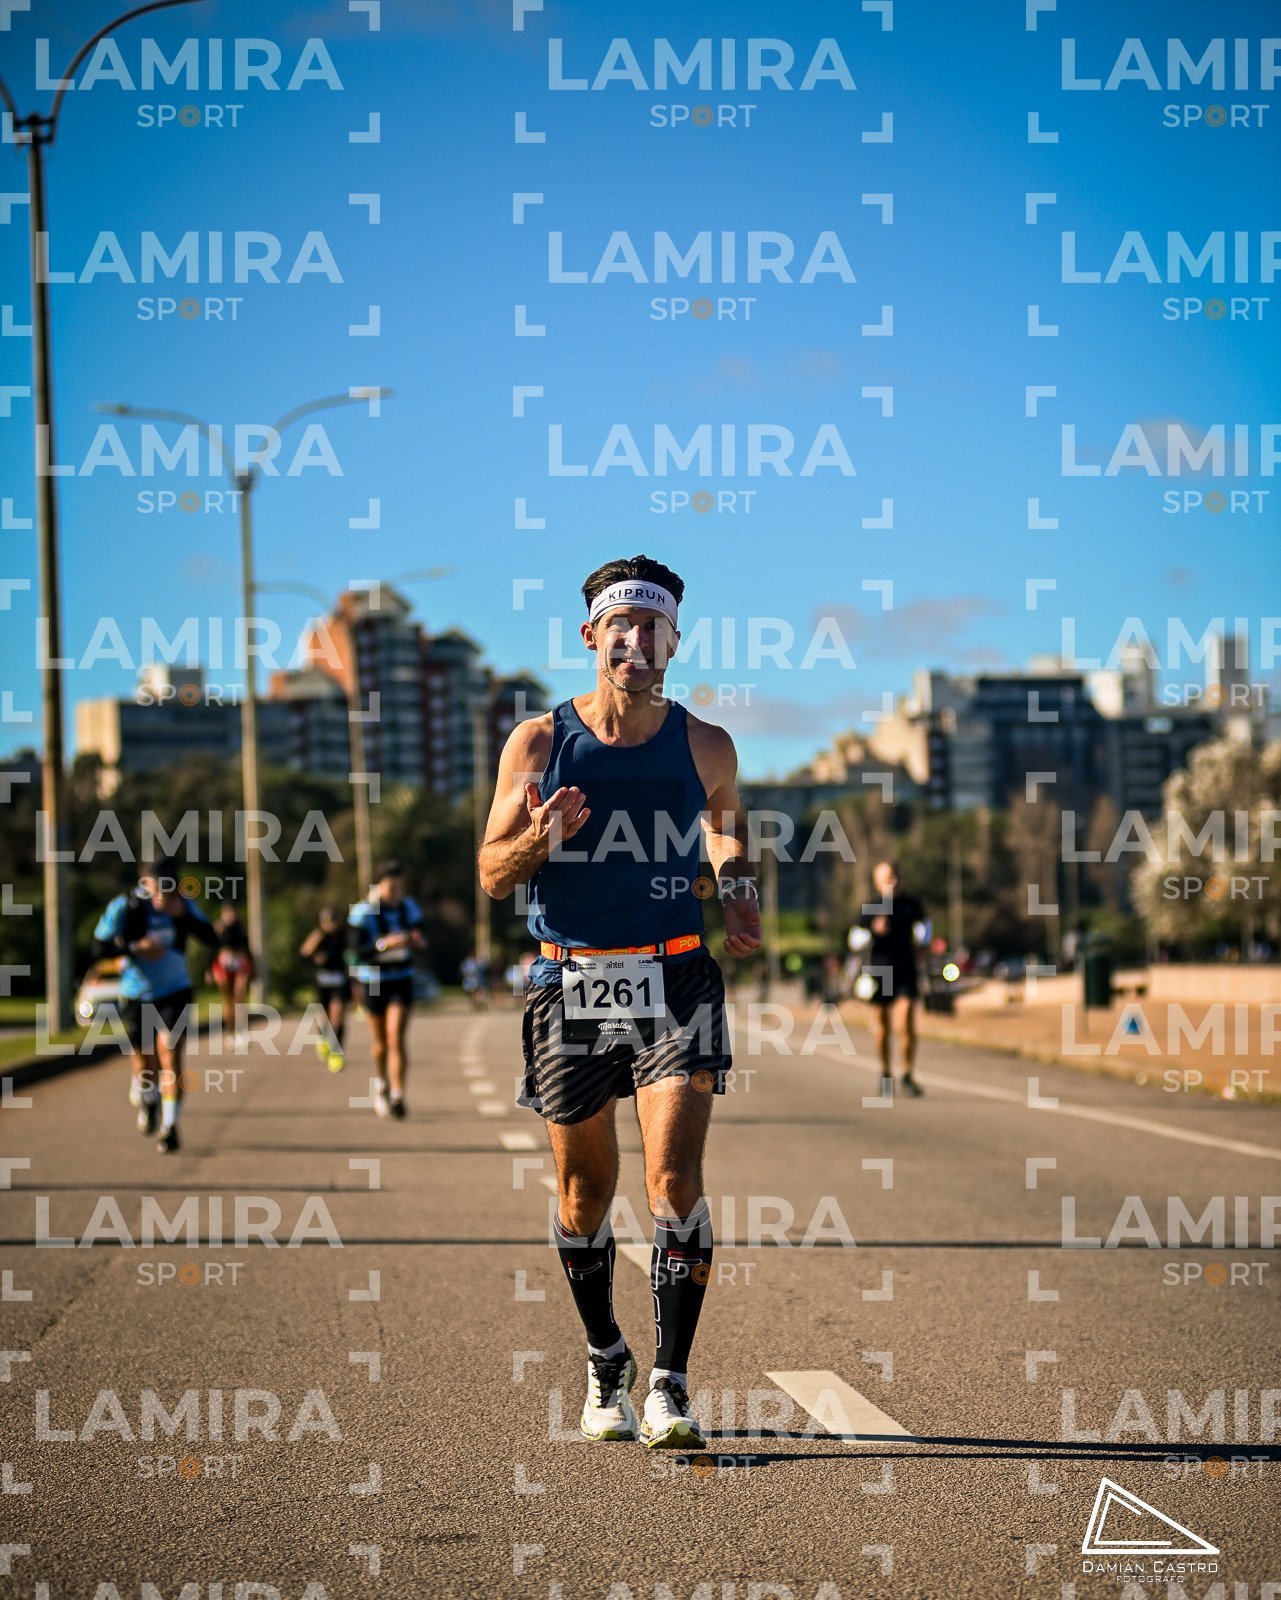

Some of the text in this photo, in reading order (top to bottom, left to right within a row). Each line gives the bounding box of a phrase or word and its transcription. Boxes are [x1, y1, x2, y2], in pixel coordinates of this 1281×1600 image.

[608, 588, 665, 605] KIPRUN
[605, 961, 624, 970] antel
[572, 977, 651, 1009] 1261
